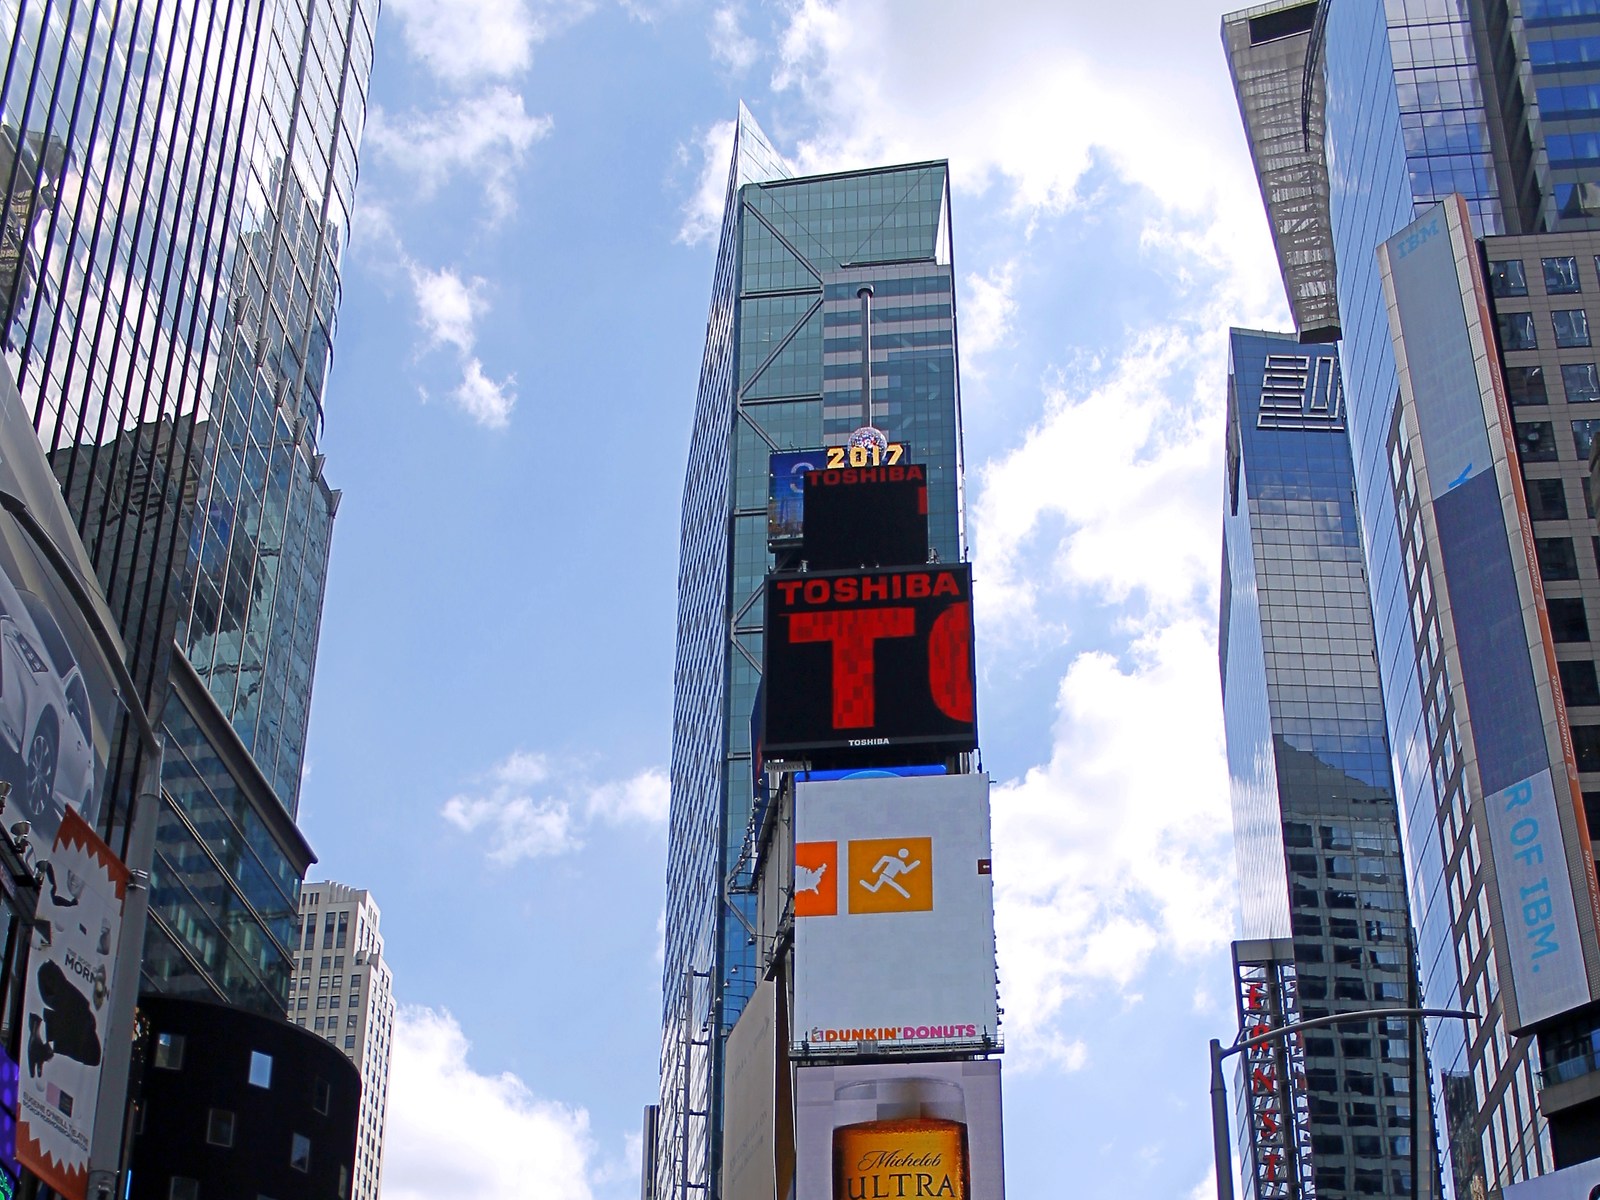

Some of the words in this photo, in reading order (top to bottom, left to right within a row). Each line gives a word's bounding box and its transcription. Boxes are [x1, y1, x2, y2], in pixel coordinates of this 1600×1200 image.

[827, 443, 904, 469] 2017
[808, 466, 923, 487] TOSHIBA
[1521, 512, 1534, 549] REUTERS
[1528, 550, 1541, 589] THOMSON
[777, 572, 960, 606] TOSHIBA
[1551, 675, 1566, 713] REUTERS
[848, 738, 890, 746] TOSHIBA
[1560, 715, 1573, 758] THOMSON
[1510, 817, 1544, 869] OF
[1584, 849, 1599, 897] REUTERS
[1519, 876, 1560, 974] IBM.
[825, 1027, 902, 1042] DUNKIN'
[903, 1024, 977, 1039] DONUTS
[1248, 983, 1281, 1181] ERNST
[857, 1149, 942, 1172] Michelob
[847, 1173, 957, 1200] ULTRA
